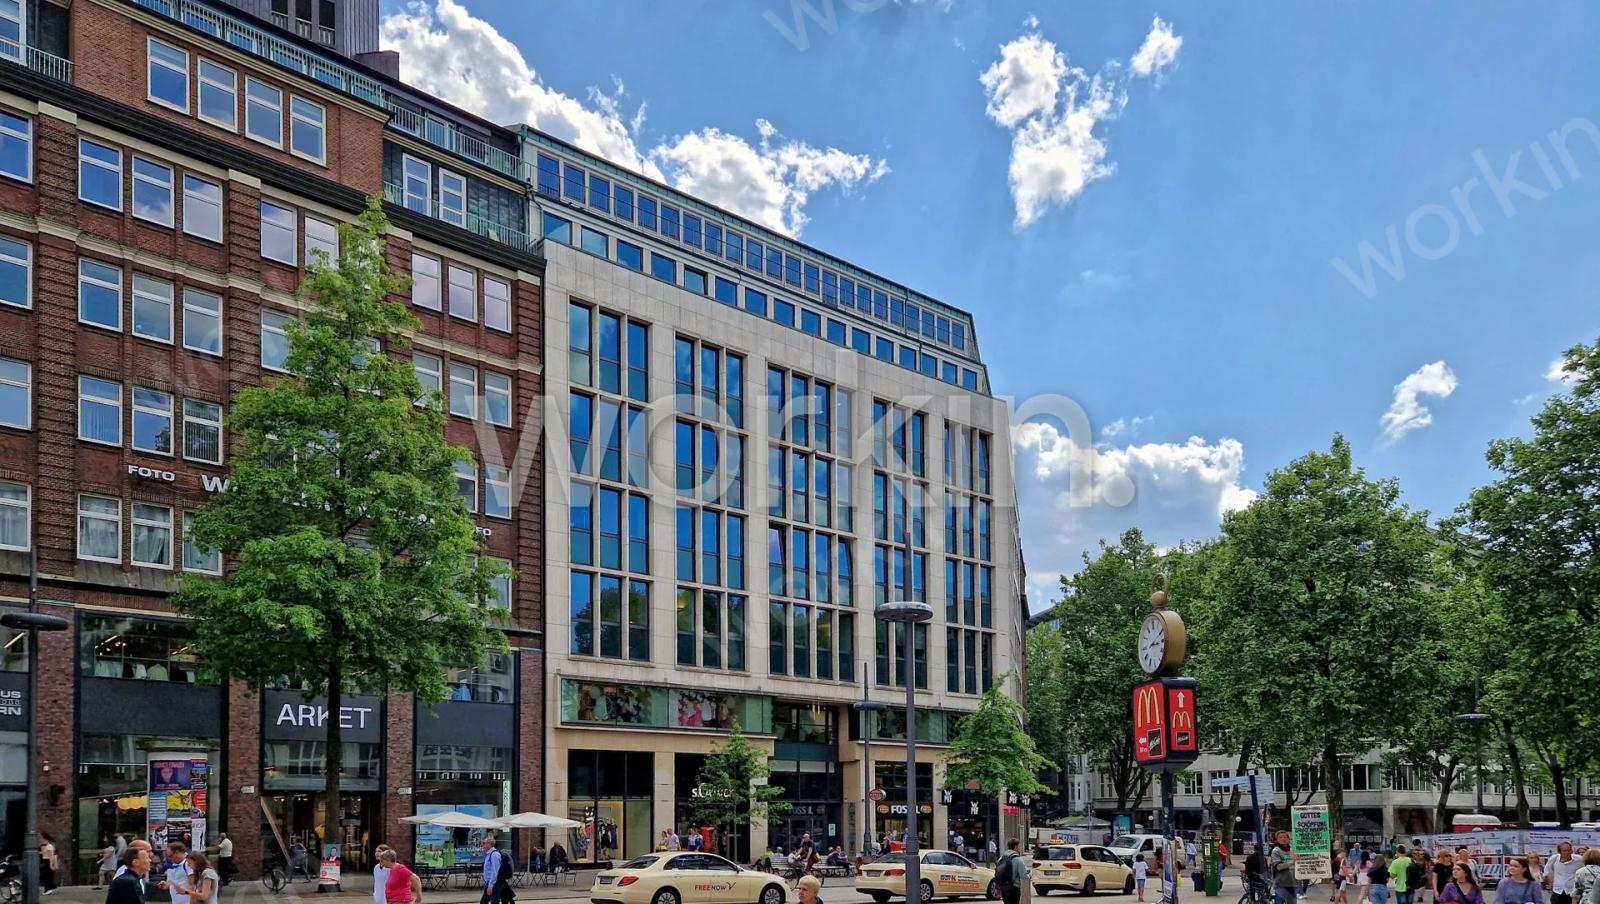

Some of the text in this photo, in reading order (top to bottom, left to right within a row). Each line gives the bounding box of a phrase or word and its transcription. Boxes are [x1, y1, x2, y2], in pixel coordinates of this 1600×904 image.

[128, 465, 175, 481] FOTO
[276, 703, 372, 728] ARKET
[891, 804, 920, 815] FOSL
